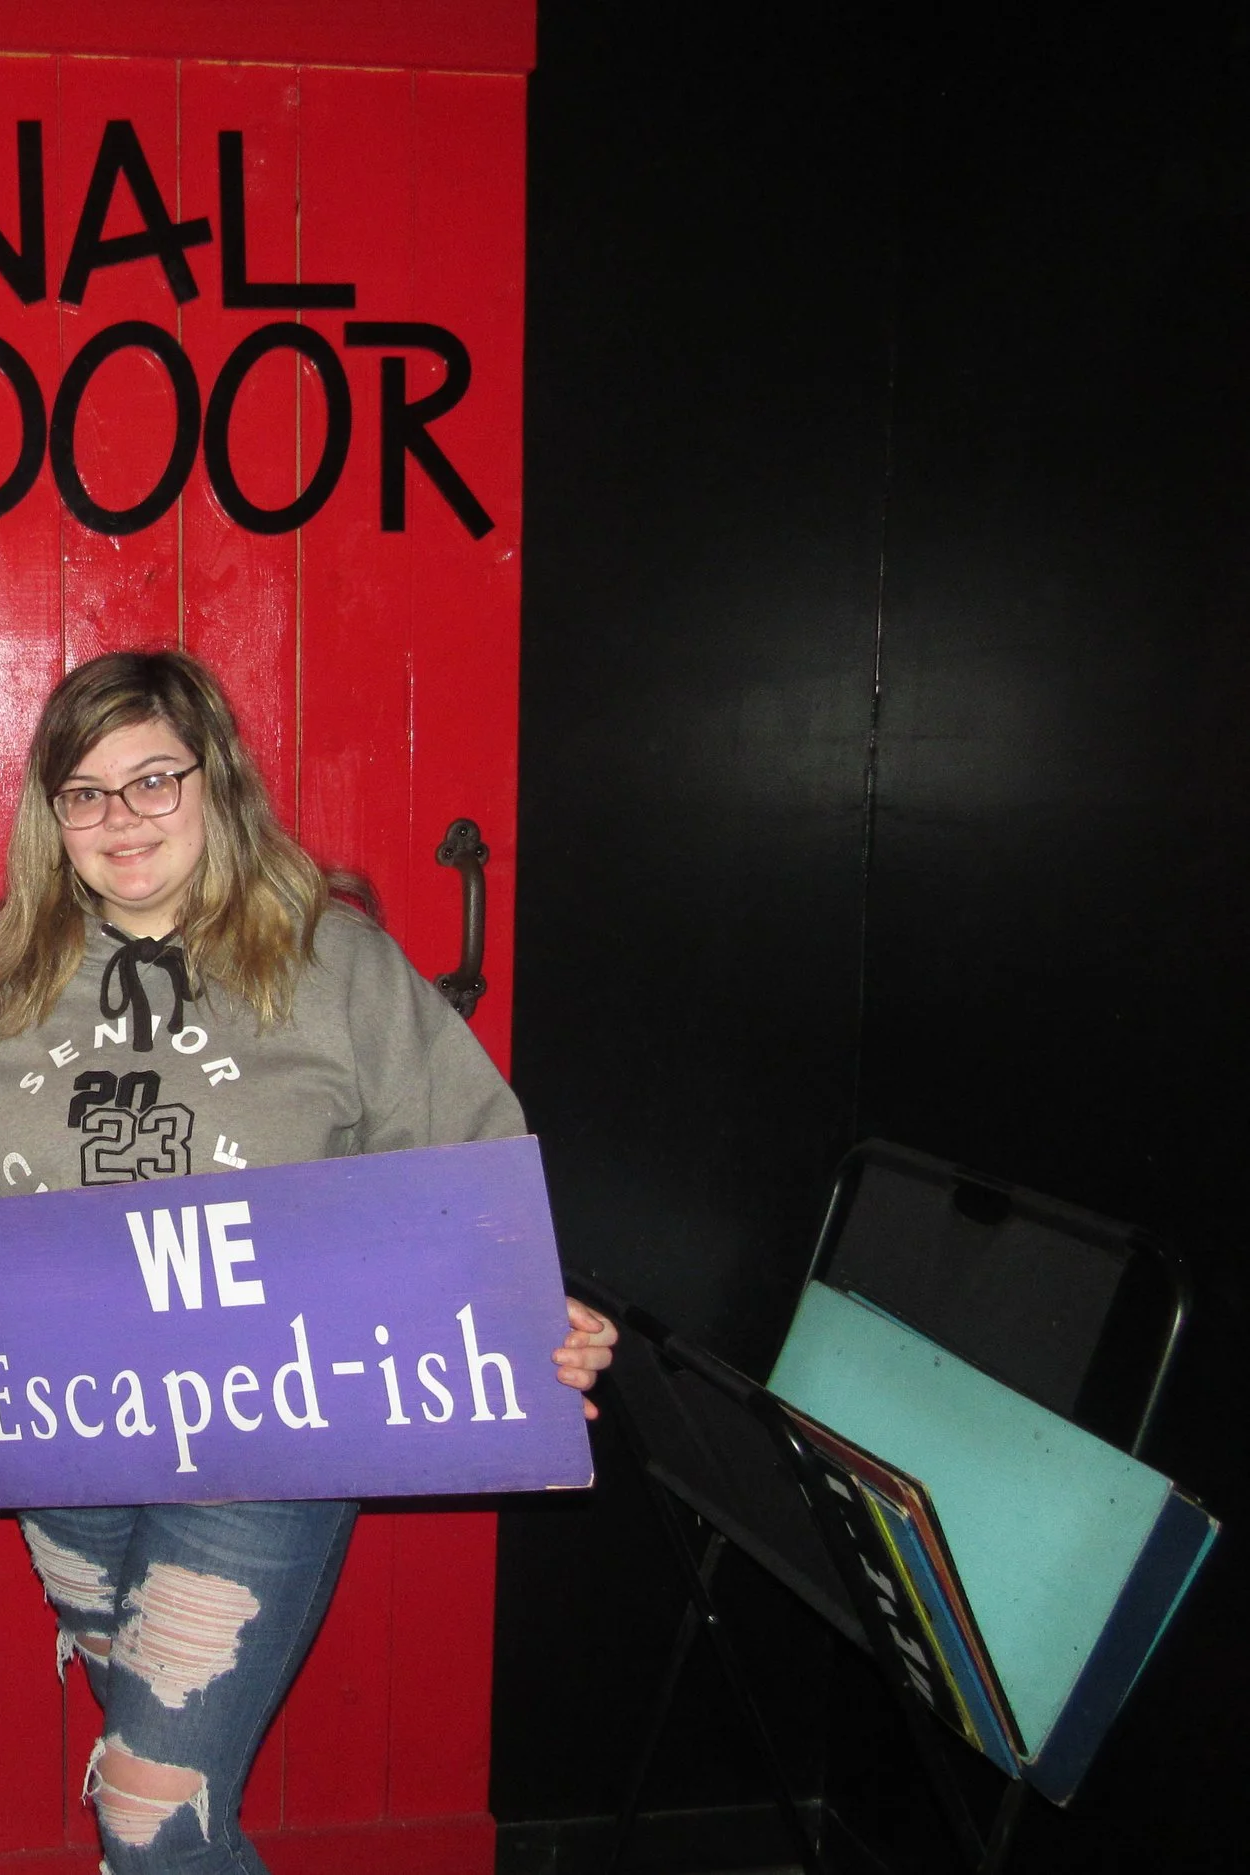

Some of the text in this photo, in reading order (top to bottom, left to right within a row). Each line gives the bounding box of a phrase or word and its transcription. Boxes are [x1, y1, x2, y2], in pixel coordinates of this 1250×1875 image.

[19, 1014, 241, 1095] SENIOR
[80, 1102, 195, 1187] 23
[125, 1200, 267, 1313] WE
